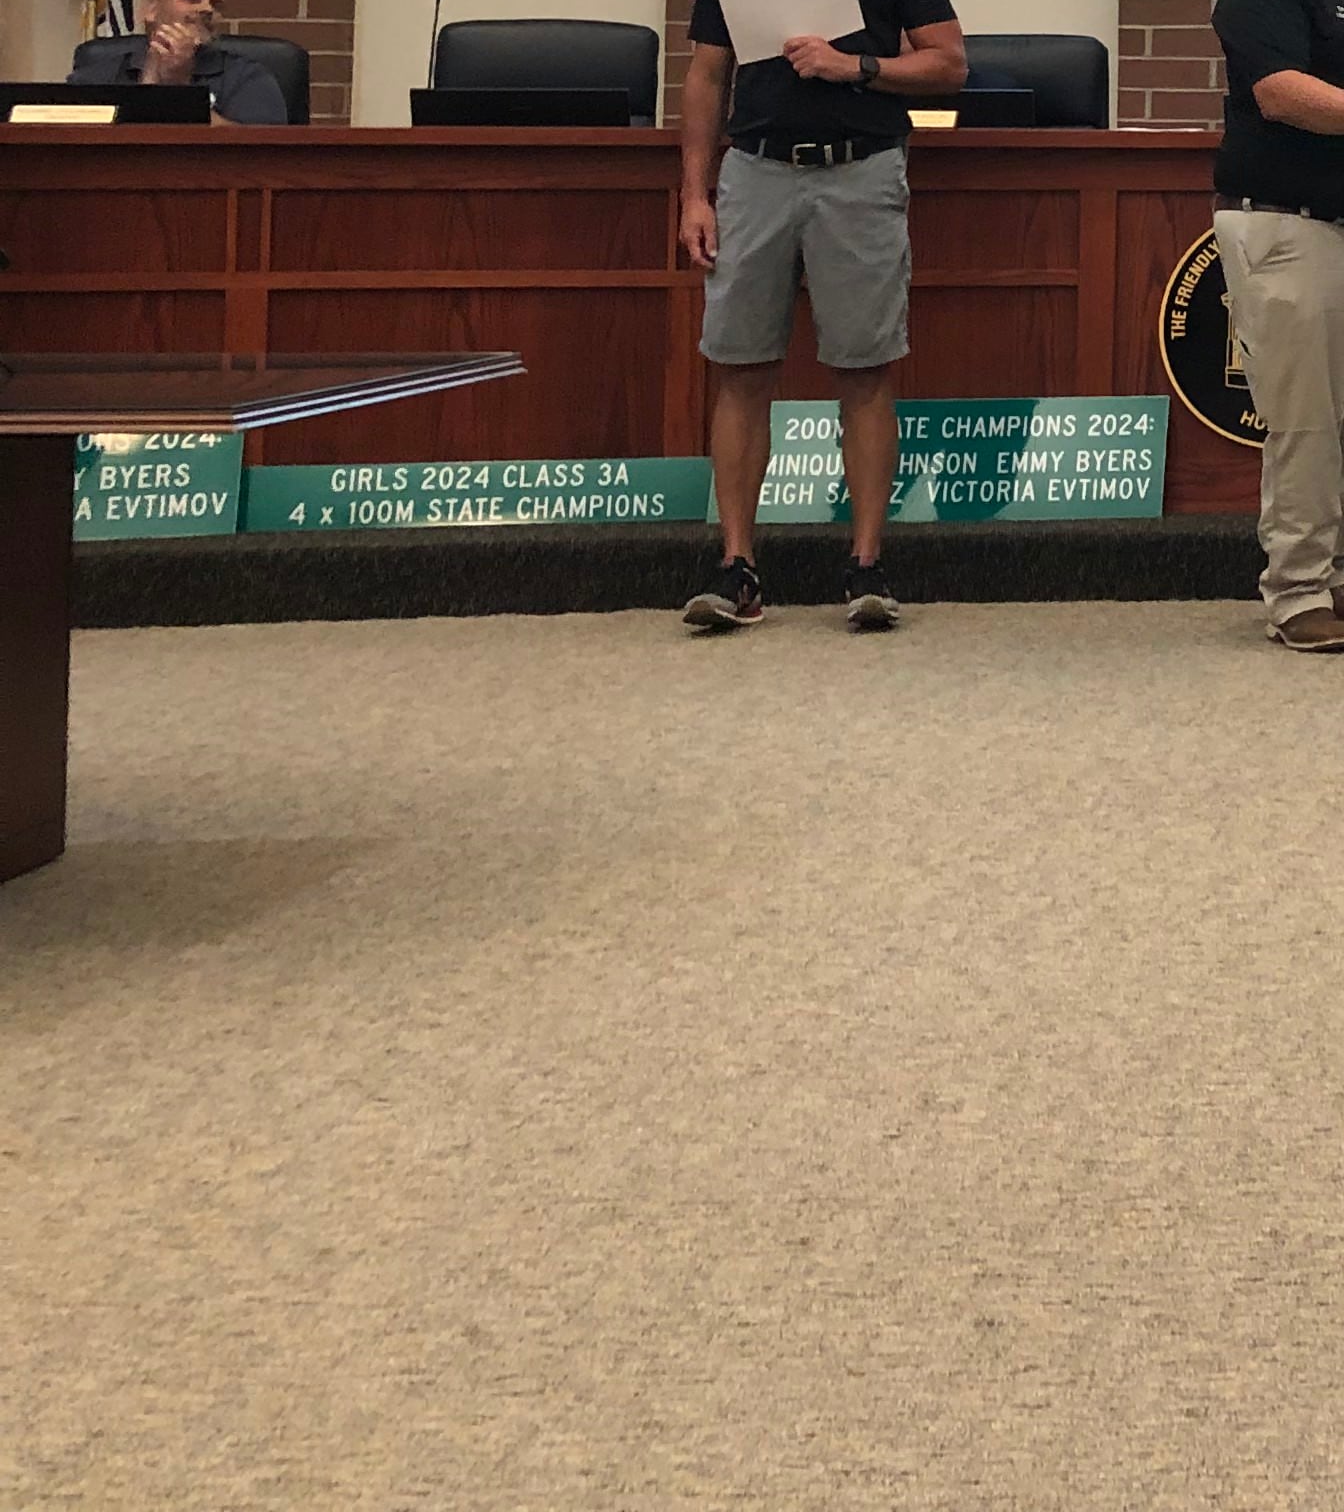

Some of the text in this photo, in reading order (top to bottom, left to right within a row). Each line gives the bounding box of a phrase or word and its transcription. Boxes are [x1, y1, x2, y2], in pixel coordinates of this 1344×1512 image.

[1170, 239, 1221, 341] THE FRIENDLY
[941, 414, 1077, 439] CHAMPIONS
[1087, 413, 1155, 437] 2024:
[898, 451, 977, 476] HNSON
[997, 450, 1065, 475] EMMY
[1075, 448, 1153, 473] BYERS
[99, 463, 191, 491] BYERS
[331, 462, 629, 493] GIRLS 2024 CLASS 3A
[758, 481, 814, 506] EIGH
[927, 479, 1035, 504] VICTORIA
[1047, 477, 1151, 502] EVTIMOV
[107, 492, 228, 520] EVTIMOV
[288, 493, 665, 526] 4 x 100M STATE CHAMPIONS
